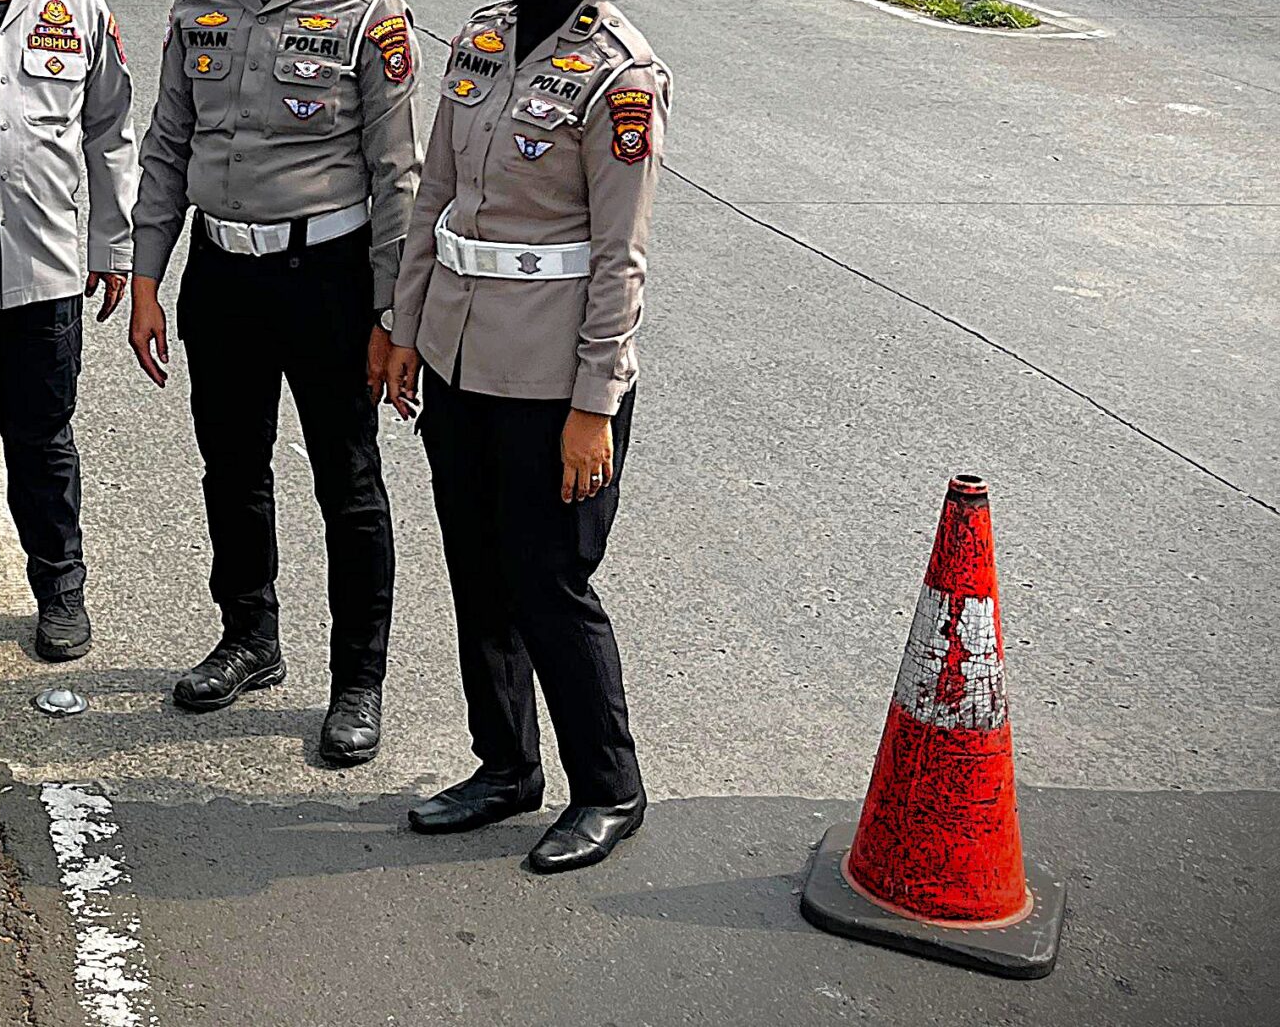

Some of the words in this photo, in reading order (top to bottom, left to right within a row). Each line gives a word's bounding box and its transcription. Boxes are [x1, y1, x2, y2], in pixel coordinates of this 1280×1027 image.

[31, 36, 79, 50] DISHUB
[187, 31, 228, 47] RYAN
[284, 35, 339, 56] POLRI
[455, 52, 502, 78] FANNY
[529, 74, 582, 101] POLRI
